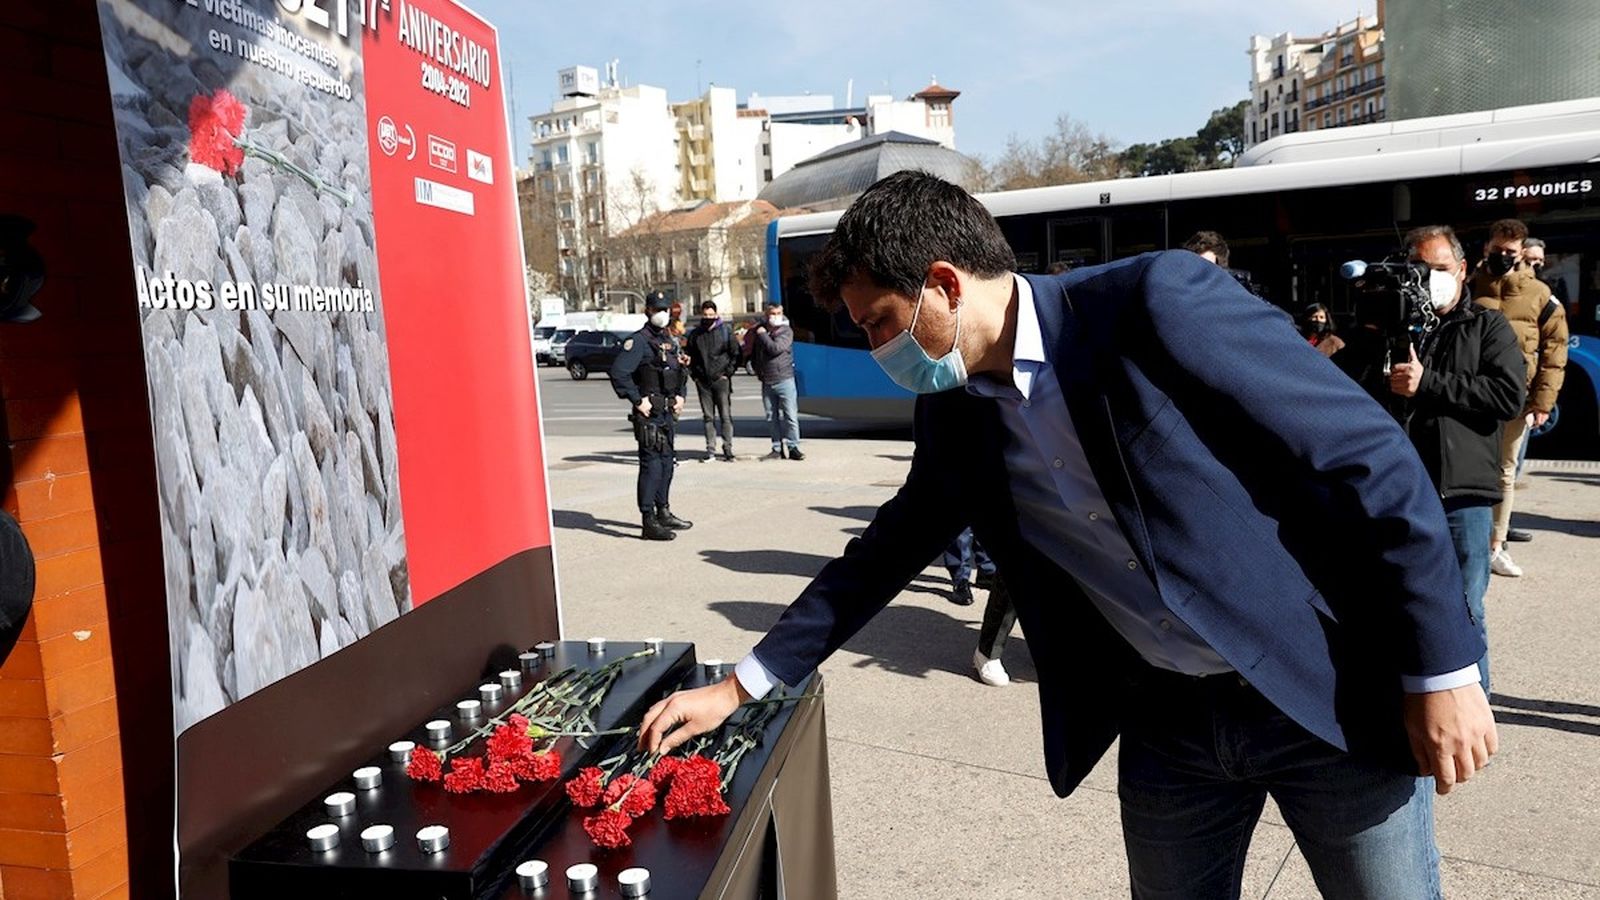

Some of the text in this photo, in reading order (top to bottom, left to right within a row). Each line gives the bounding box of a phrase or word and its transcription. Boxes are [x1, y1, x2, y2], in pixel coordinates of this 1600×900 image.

[208, 29, 351, 101] en nuestro recuerdo
[275, 17, 338, 68] inocentes
[399, 0, 490, 88] ANIVERSARIO
[421, 62, 470, 107] 2004-2021
[1475, 180, 1593, 201] 32 PAVONES
[137, 265, 375, 312] Actos en su memoria
